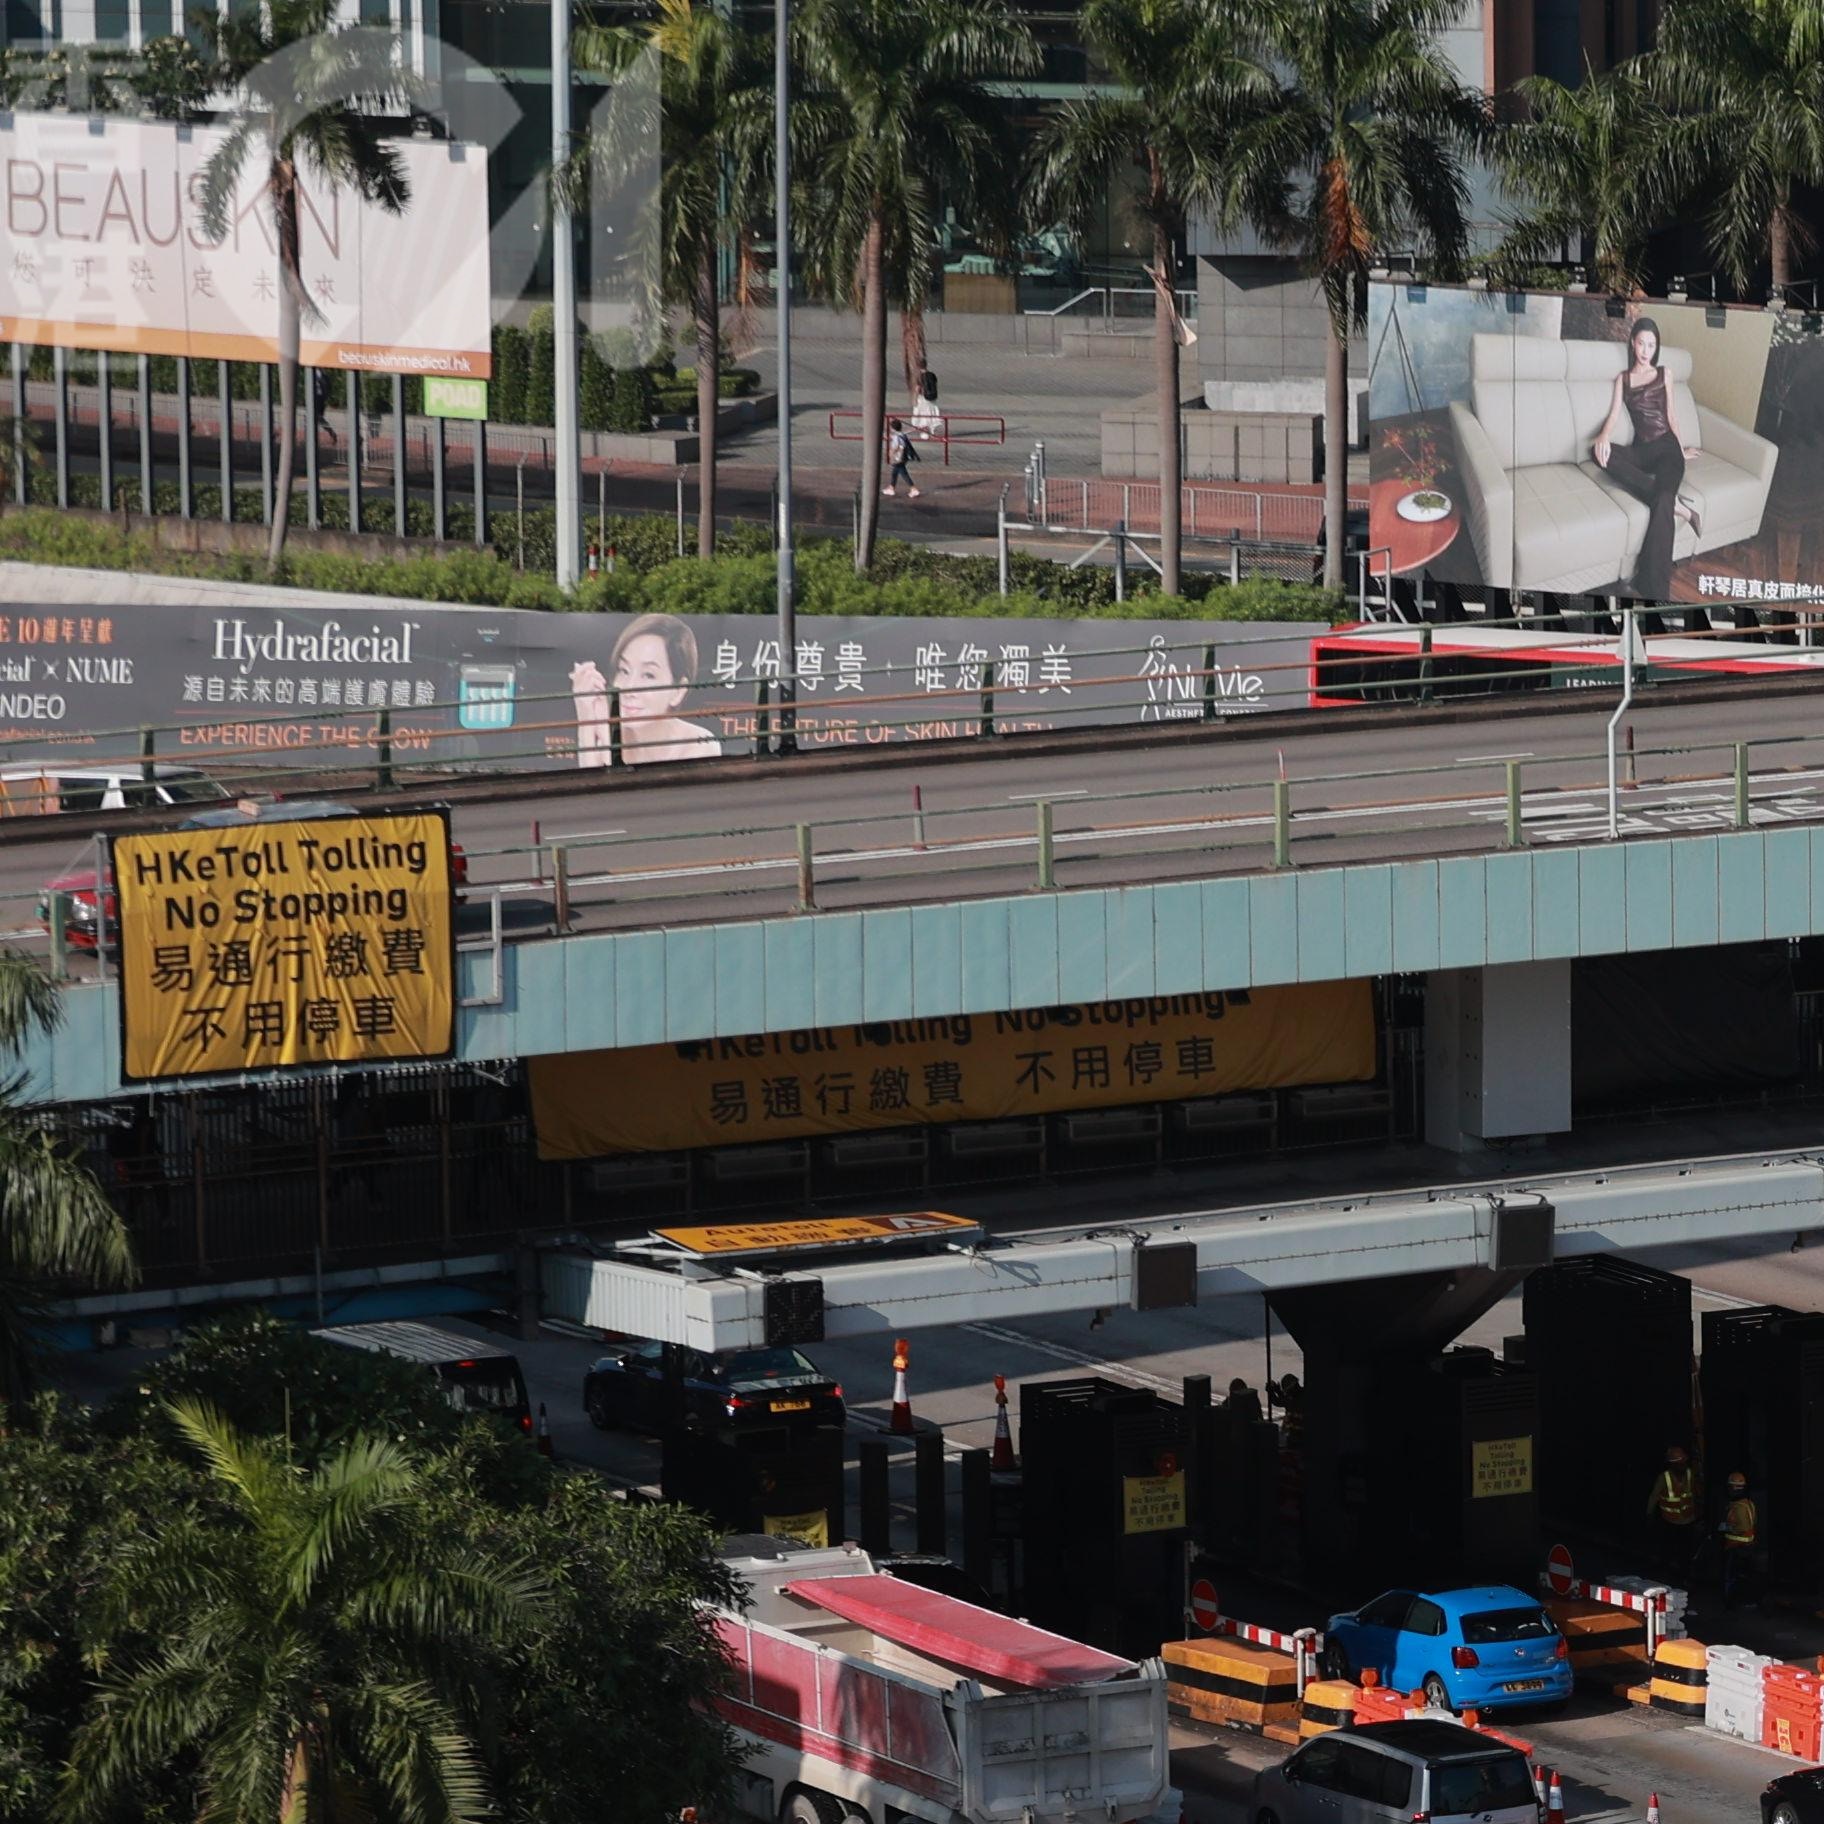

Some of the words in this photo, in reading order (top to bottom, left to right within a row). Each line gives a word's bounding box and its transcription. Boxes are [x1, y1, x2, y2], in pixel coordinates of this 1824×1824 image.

[6, 158, 341, 261] BEAUSKN
[66, 657, 134, 684] NUME
[211, 619, 413, 674] Hydrafacial
[181, 724, 312, 746] EXPERIENCE
[771, 719, 858, 743] FTURE
[135, 842, 288, 885] HKeToll
[300, 836, 427, 875] Tolling
[165, 895, 220, 930] No
[234, 882, 409, 924] Stopping
[151, 928, 427, 995] 易通行繳費
[182, 996, 396, 1053] 不用停車
[709, 1060, 966, 1126] 易通行繳費
[1014, 1034, 1219, 1096] 不用停車
